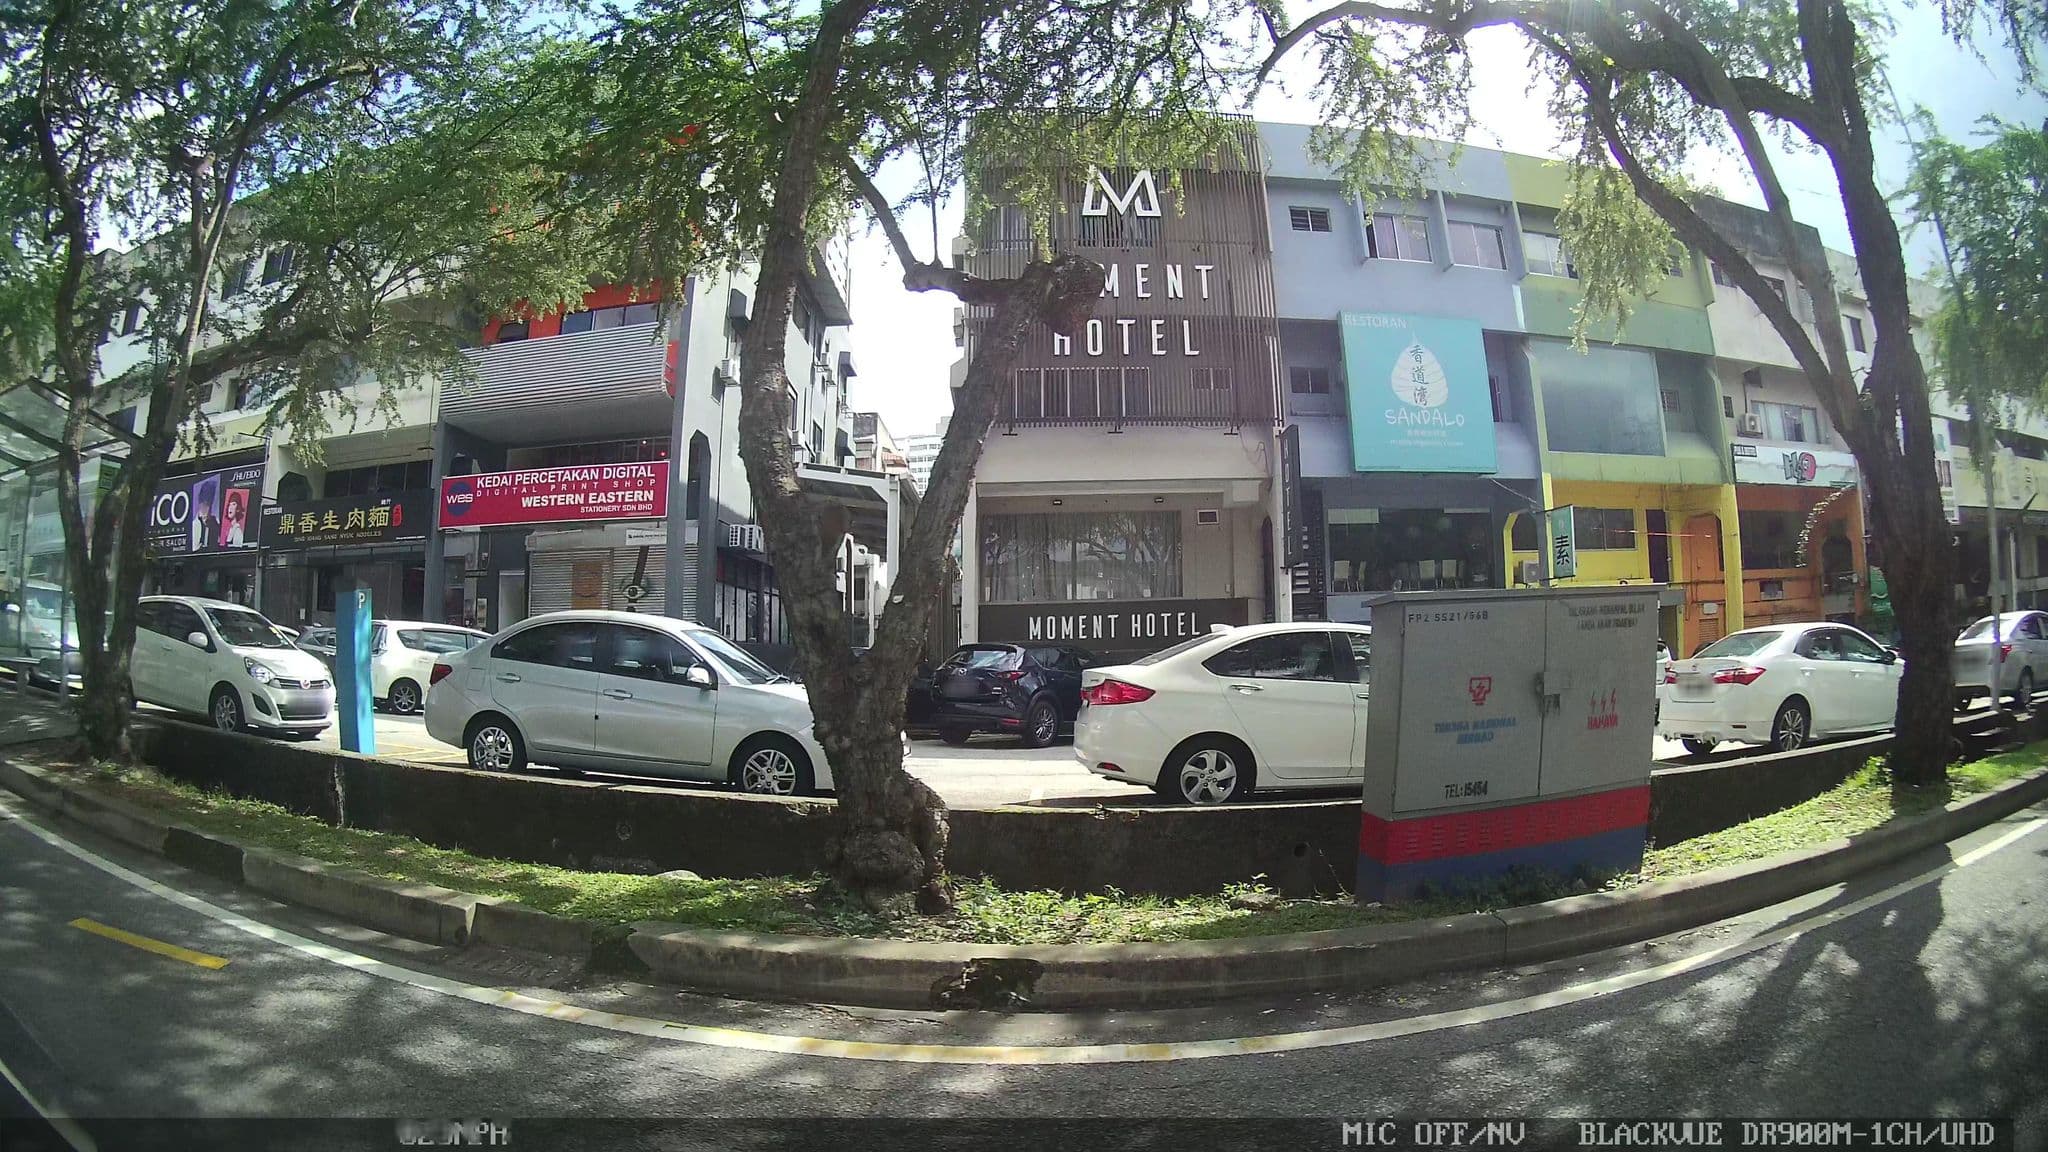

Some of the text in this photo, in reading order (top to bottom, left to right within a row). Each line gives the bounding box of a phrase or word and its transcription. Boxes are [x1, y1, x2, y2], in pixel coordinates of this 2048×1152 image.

[1099, 263, 1214, 300] MENT
[1344, 314, 1408, 329] RESTORAN
[1053, 319, 1200, 356] HOTEL
[1384, 407, 1465, 427] SANDALO
[477, 465, 655, 489] KEDAI PERCETAKAN DIGITAL
[476, 479, 656, 497] DIGITAL PRINT SHOP
[521, 489, 655, 508] WESTERN EASTERN
[580, 503, 653, 513] STATIONERY SDN BHD
[1555, 535, 1570, 565] 素
[358, 592, 366, 609] P
[1029, 611, 1201, 640] MOMENT HOTEL
